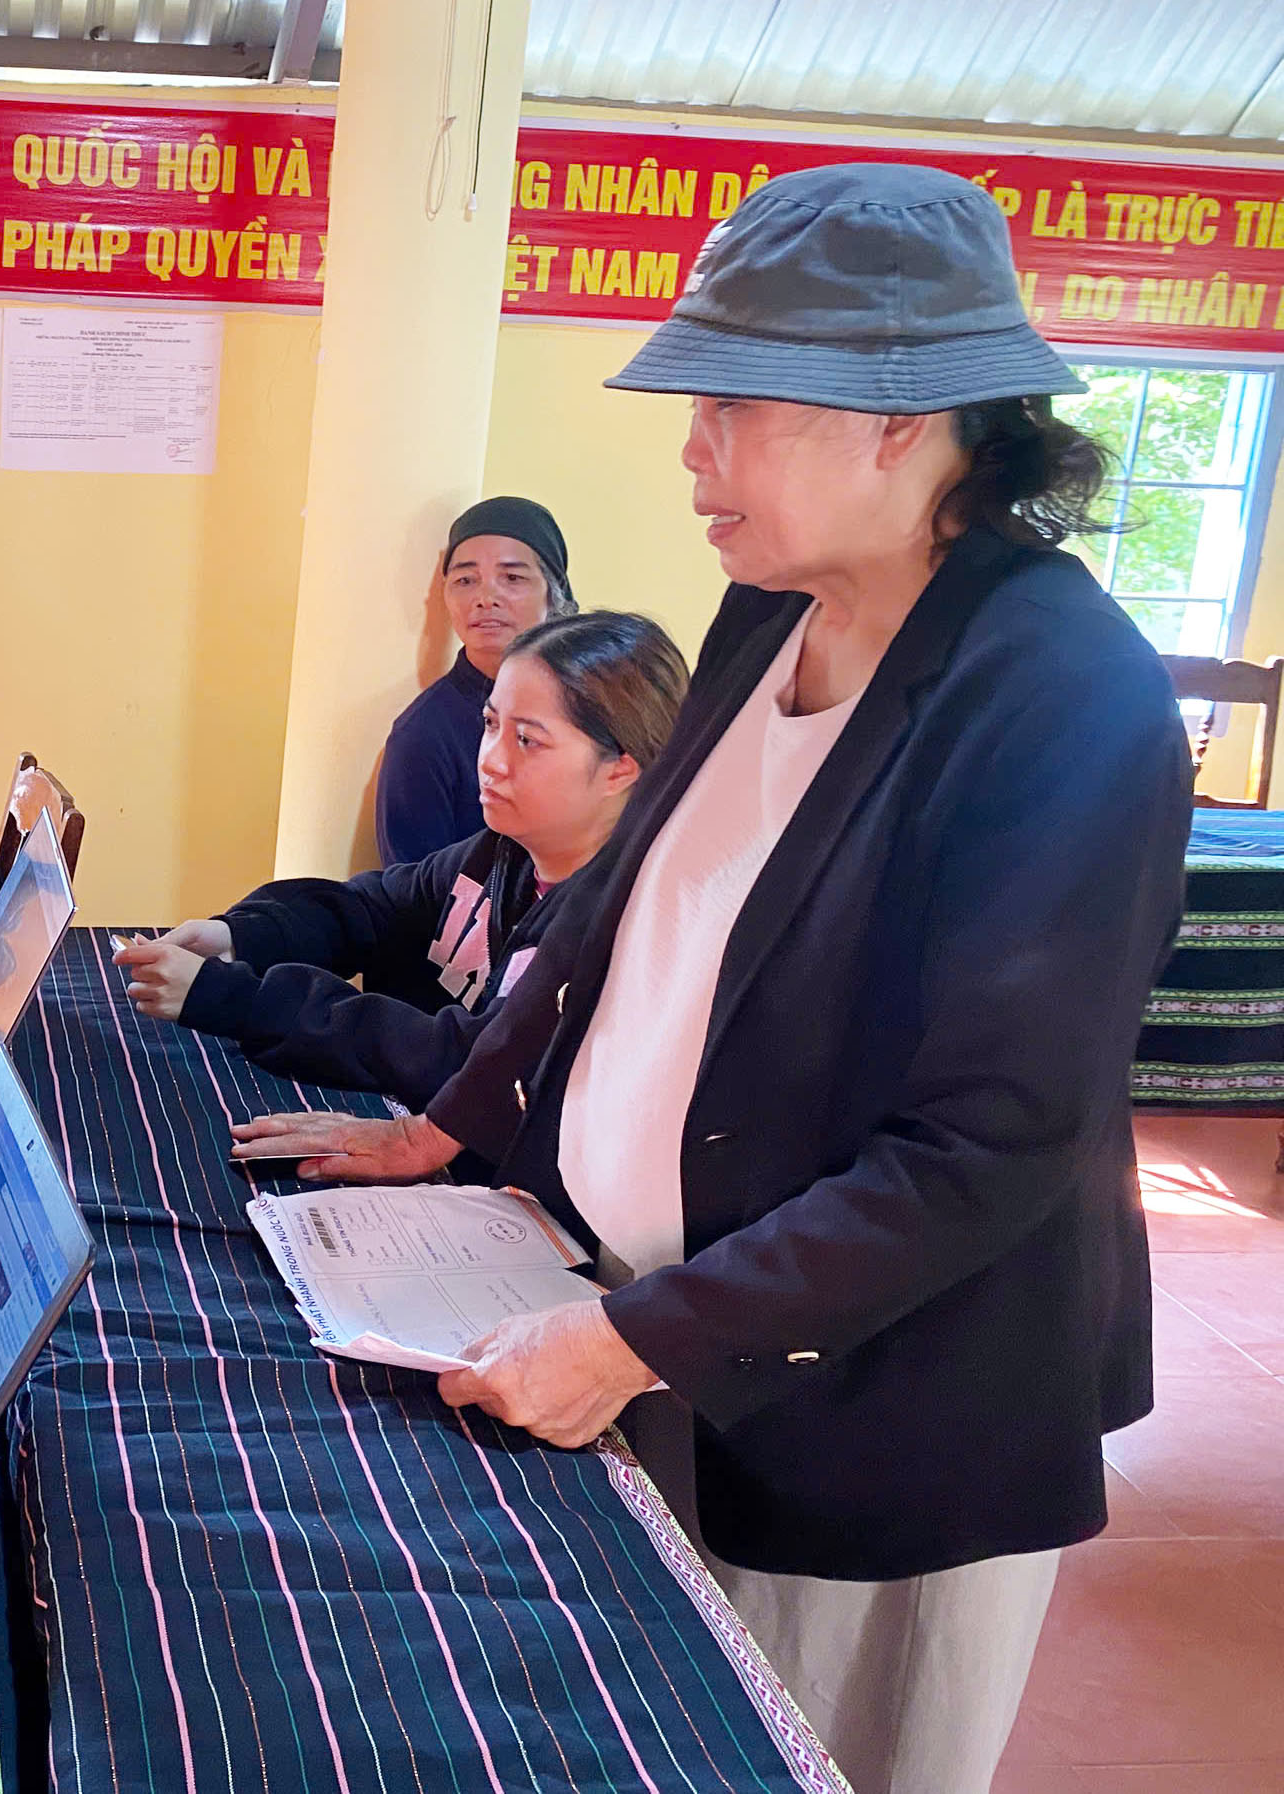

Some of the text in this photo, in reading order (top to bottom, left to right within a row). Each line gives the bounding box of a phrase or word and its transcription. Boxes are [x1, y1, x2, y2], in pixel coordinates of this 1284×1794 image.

[13, 121, 142, 190] QUỐC
[156, 133, 237, 204] HỘI
[253, 137, 312, 197] VÀ
[564, 157, 698, 218] NHÂN
[708, 163, 771, 220] DÂ
[1031, 181, 1087, 240] LÀ
[1105, 192, 1221, 255] TRỰC
[2, 212, 131, 273] PHÁP
[145, 216, 301, 282] QUYỀN
[503, 234, 559, 302] ỆT
[569, 247, 680, 299] NAM
[1060, 273, 1123, 322] DO
[1134, 271, 1268, 329] NHÂN
[281, 1245, 302, 1276] TRONG
[294, 1277, 317, 1308] NHANH
